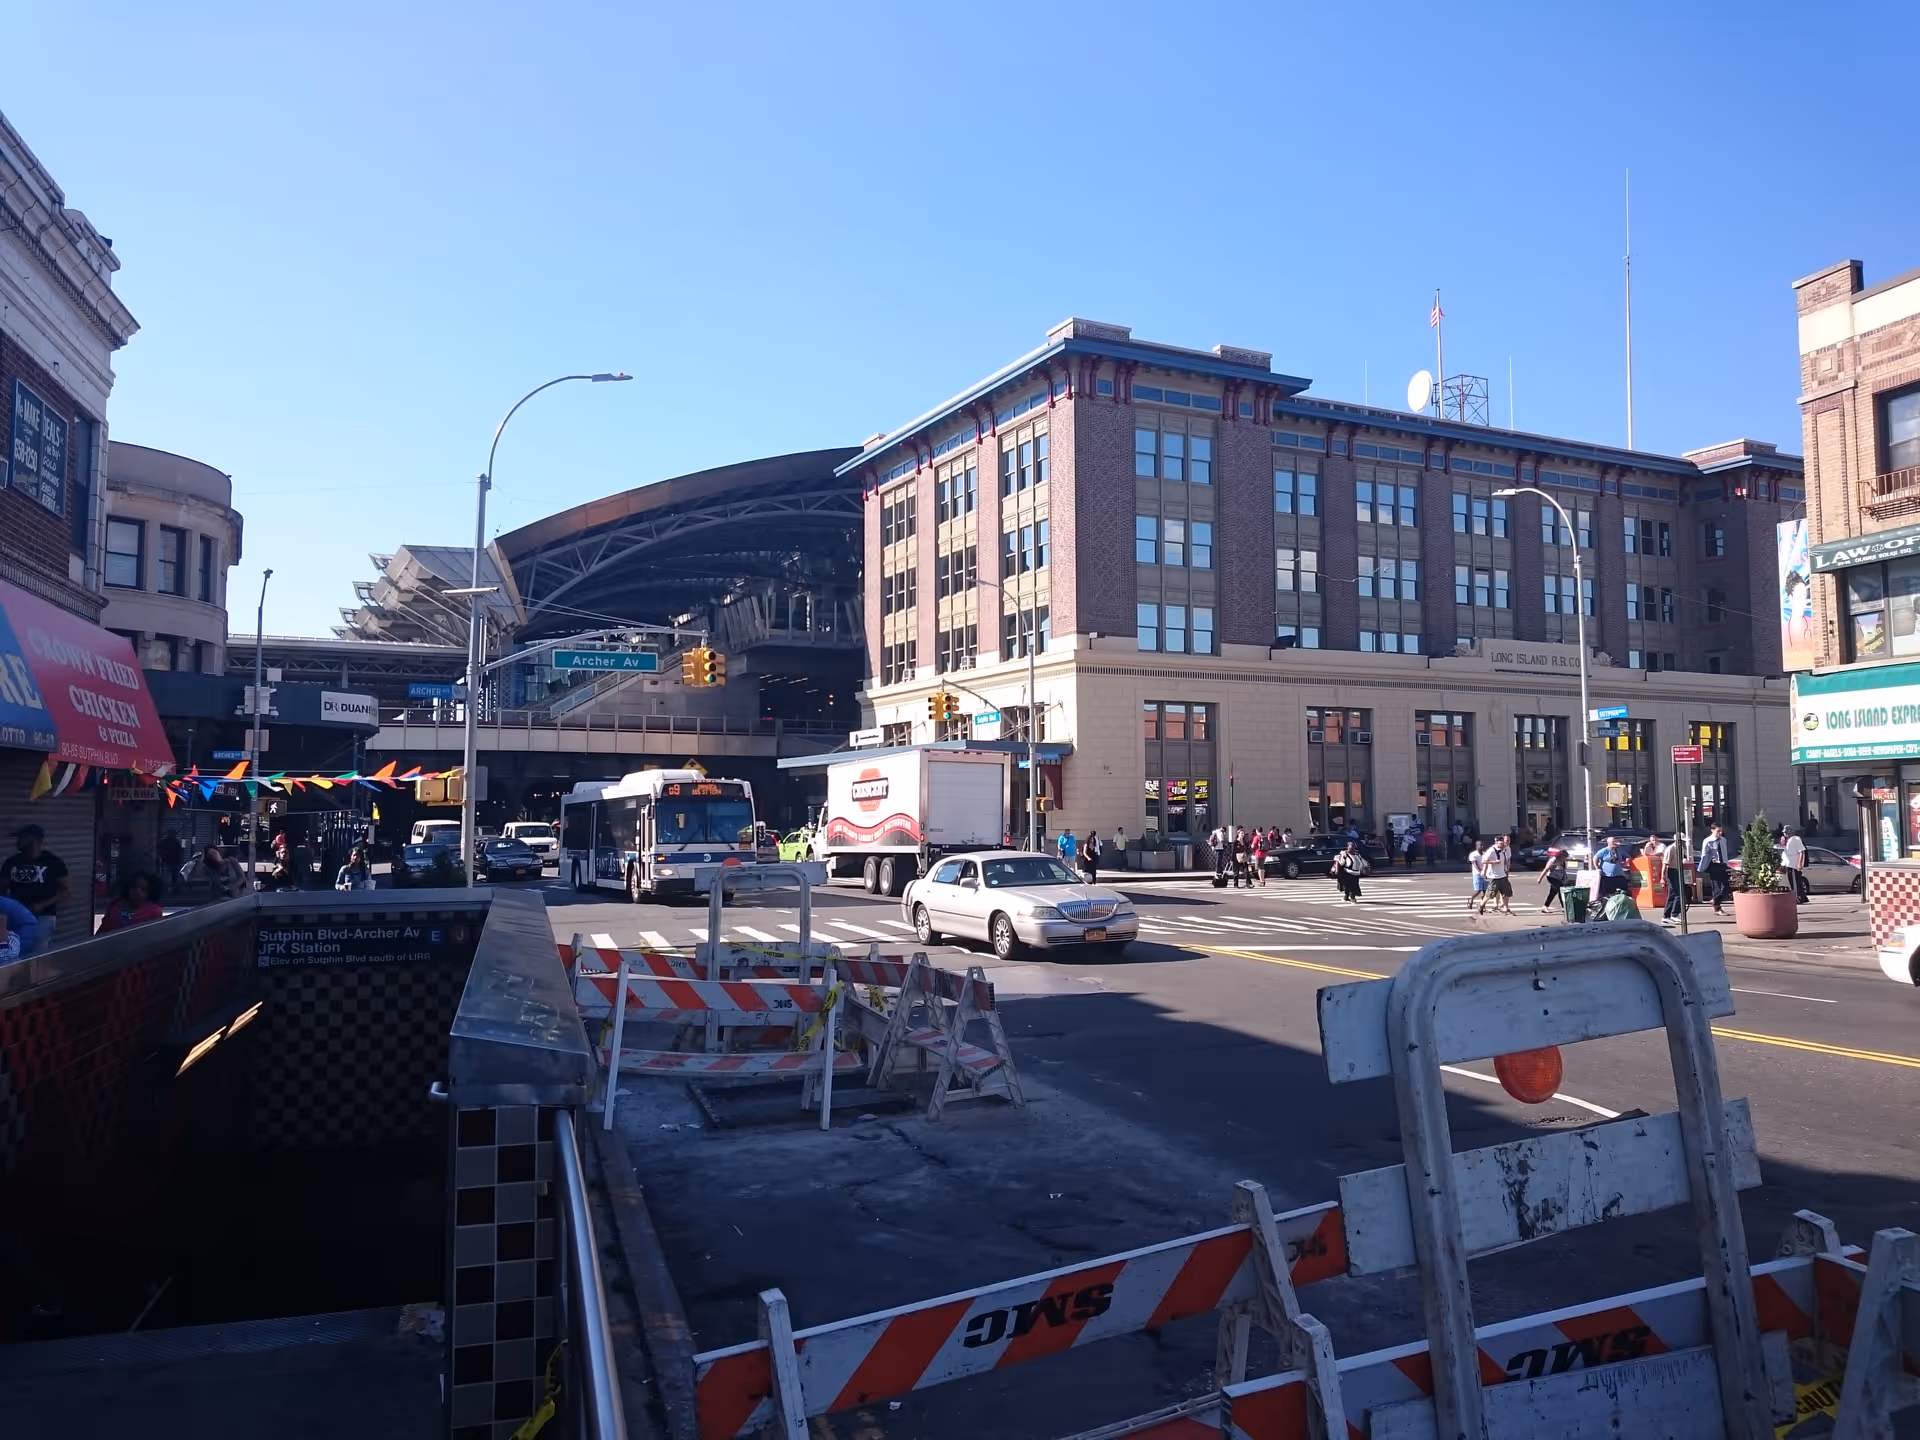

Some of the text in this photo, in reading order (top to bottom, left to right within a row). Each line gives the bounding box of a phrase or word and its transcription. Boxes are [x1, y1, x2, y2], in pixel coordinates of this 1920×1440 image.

[23, 399, 40, 432] MAKE
[43, 416, 60, 447] DEALS
[43, 457, 57, 471] GOLD
[1816, 546, 1871, 569] LAW
[26, 626, 140, 691] CROWN FRIED
[572, 655, 639, 667] Archer Av
[1491, 651, 1513, 664] LONG
[1516, 653, 1548, 666] ISLAND
[411, 687, 441, 697] ARCHER
[68, 684, 141, 729] CHICKEN
[1826, 709, 1852, 730] LONG
[1854, 706, 1889, 729] ISLAND
[110, 727, 138, 749] PIZZA
[104, 750, 118, 765] BLVD
[259, 930, 314, 944] Sutphin
[317, 927, 400, 941] Blvd-Archer
[403, 926, 421, 938] Av
[431, 930, 441, 942] E
[258, 942, 341, 955] JFK Station
[270, 957, 291, 966] Elev
[293, 957, 305, 965] on
[307, 955, 343, 966] Sutphin
[345, 954, 367, 963] Blvd
[368, 953, 395, 963] south
[963, 1283, 1115, 1349] SMC
